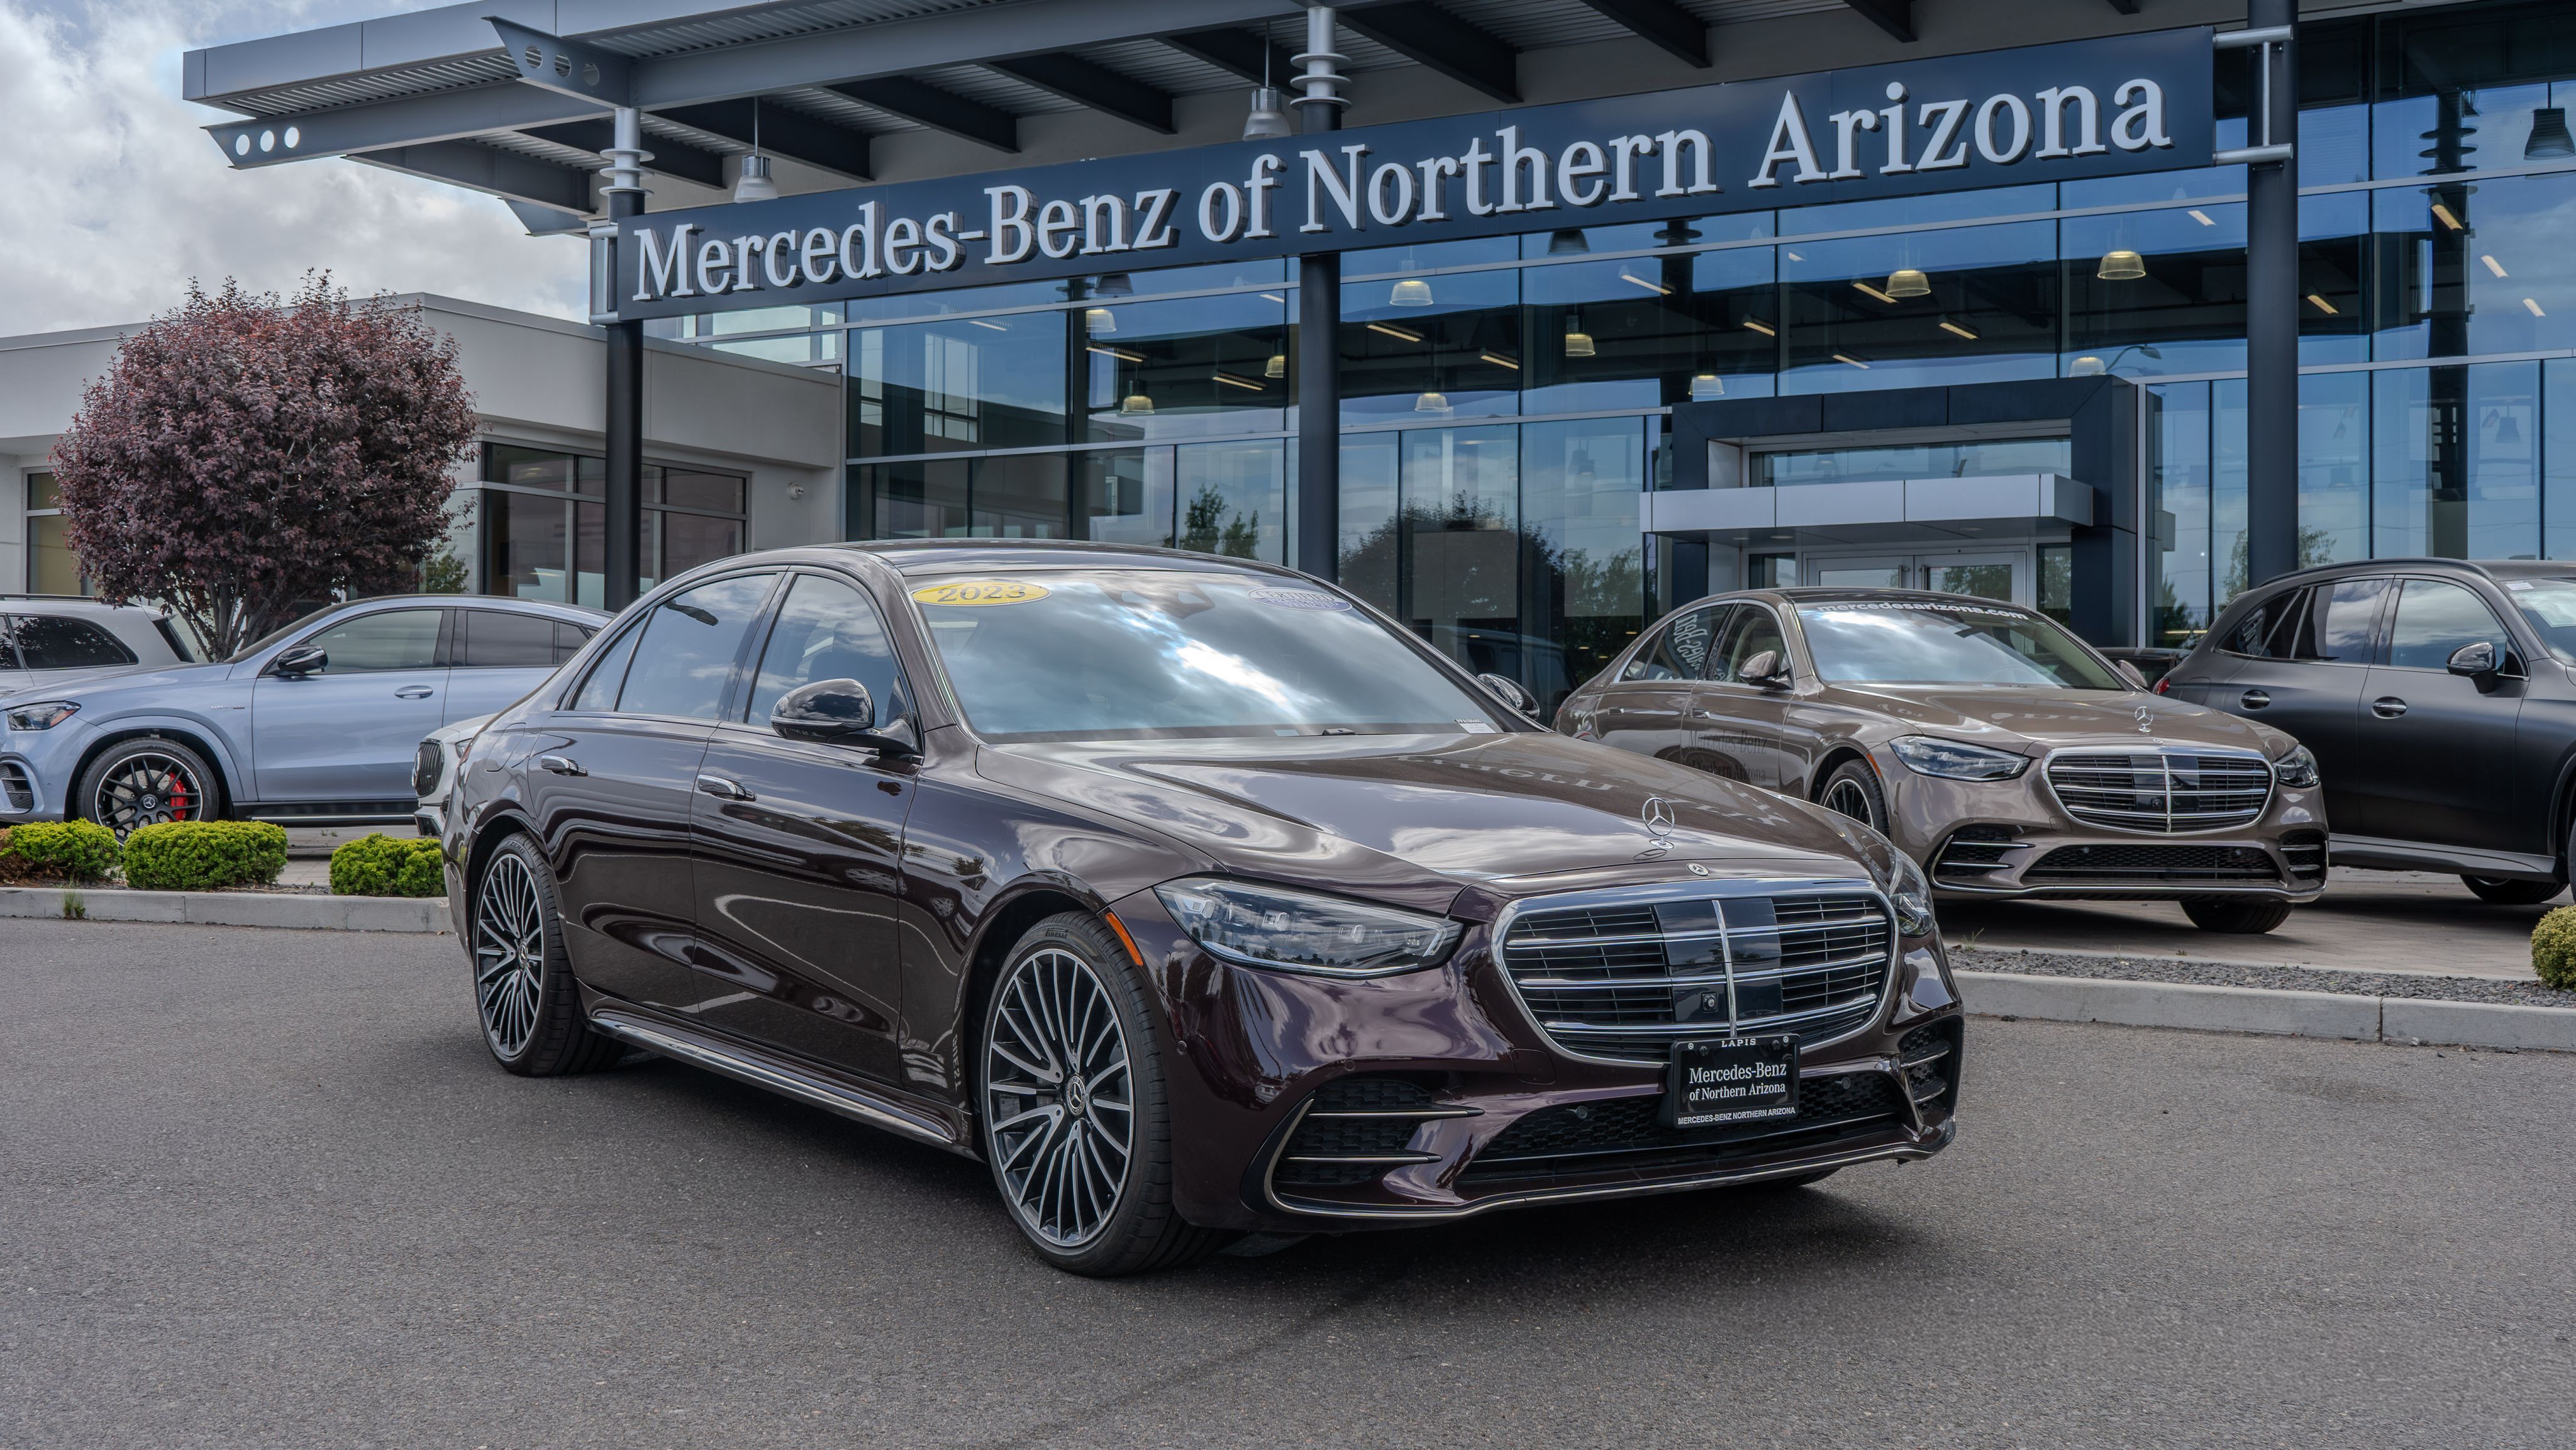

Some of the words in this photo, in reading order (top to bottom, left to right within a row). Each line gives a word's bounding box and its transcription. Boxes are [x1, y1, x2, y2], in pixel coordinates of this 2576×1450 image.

[632, 184, 1177, 302] Mercedes-Benz
[1197, 153, 1287, 244] of
[1299, 125, 1724, 234] Northern
[1747, 78, 2175, 189] Arizona
[937, 585, 1026, 602] 2023
[1256, 591, 1335, 601] CERTIFIED
[1816, 602, 2029, 620] mercedesarizona.com
[1689, 730, 1767, 754] Mercedes-Benz
[1734, 761, 1766, 781] Arizona
[510, 842, 525, 854] ZERO
[1045, 928, 1069, 939] PIRELLI
[1721, 1038, 1757, 1047] LAPIS
[1689, 1062, 1787, 1084] Mercedes-Benz
[1689, 1087, 1700, 1101] of
[1701, 1086, 1746, 1100] Northern
[1748, 1083, 1785, 1096] Arizona
[1677, 1113, 1732, 1125] MERCEDES-BENZ
[1733, 1109, 1767, 1120] NORTHERN
[1768, 1107, 1796, 1117] ARIZONA
